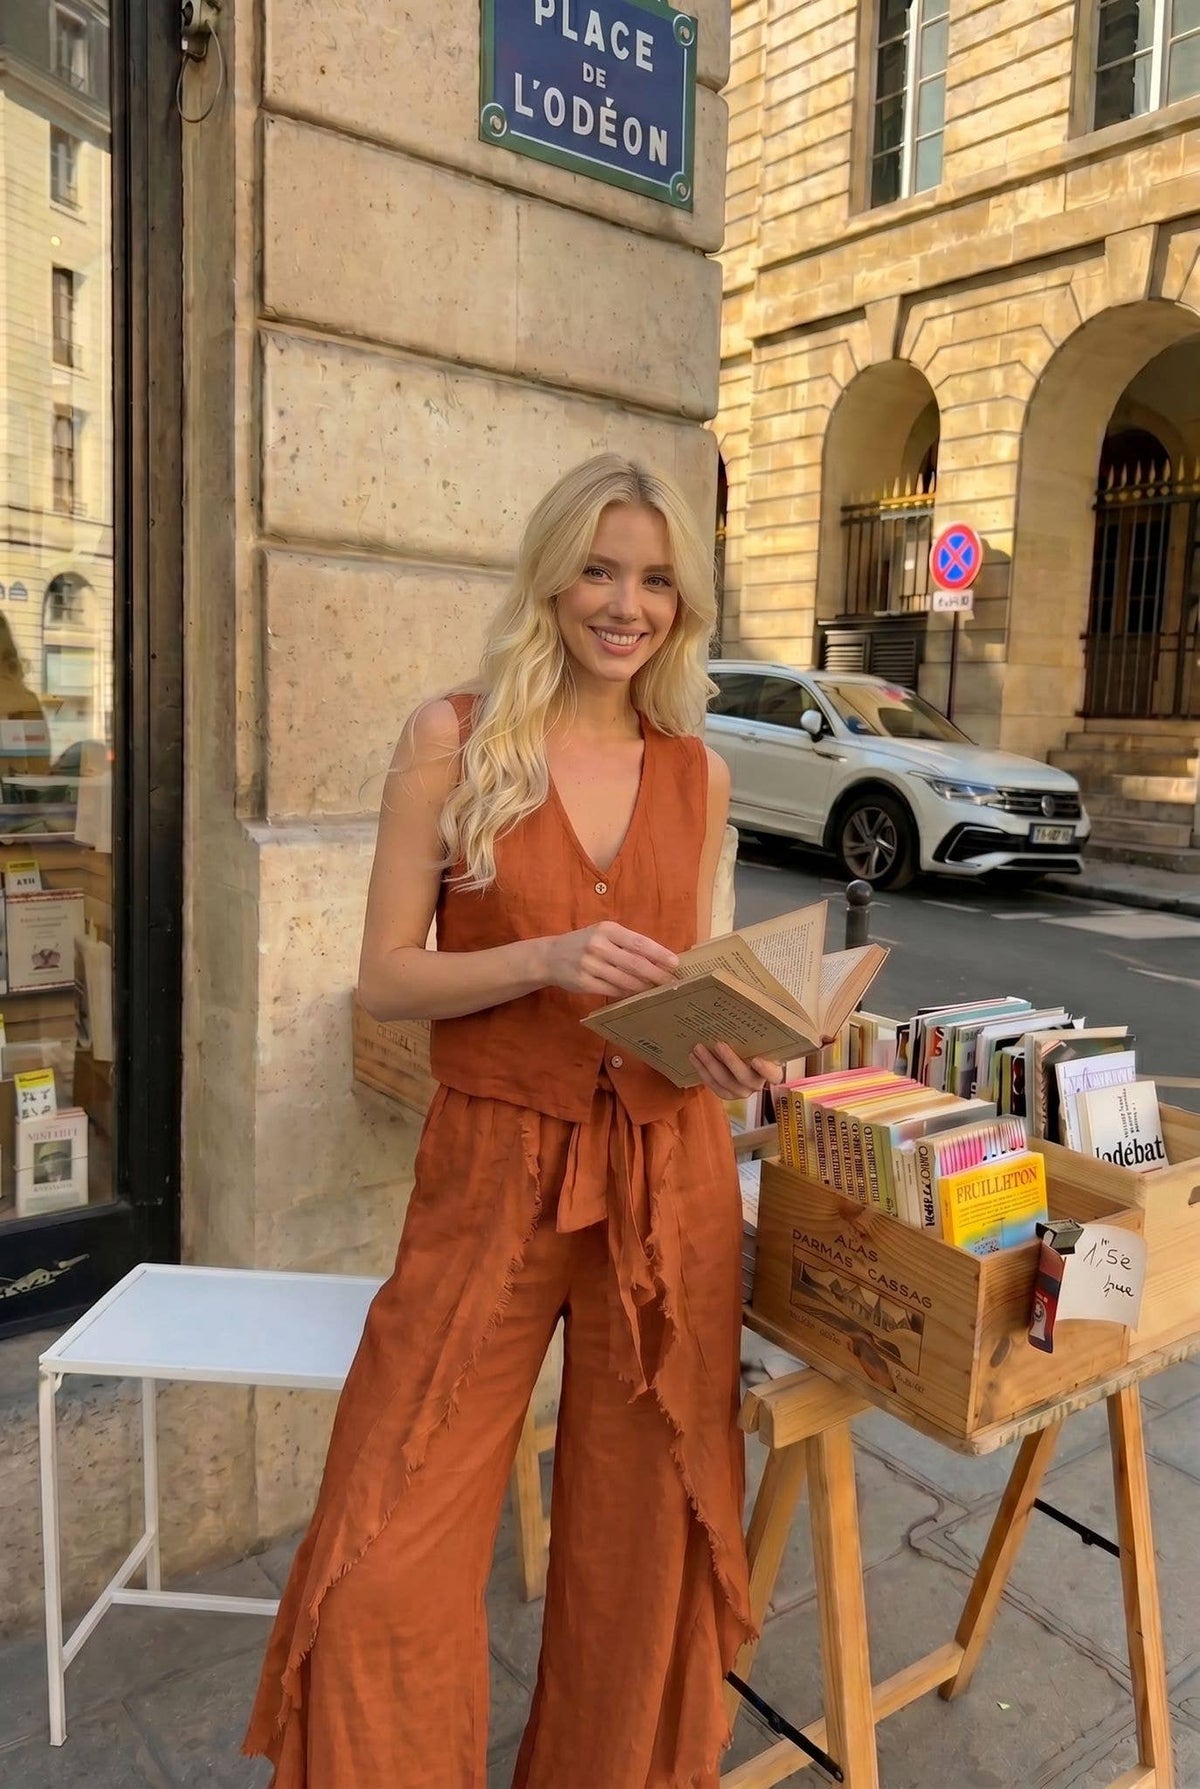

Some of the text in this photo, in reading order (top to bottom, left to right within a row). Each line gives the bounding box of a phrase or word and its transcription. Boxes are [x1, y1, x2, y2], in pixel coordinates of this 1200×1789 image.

[535, 0, 653, 72] PLACE
[583, 62, 606, 88] DE
[515, 72, 667, 166] L'ODÉON
[792, 1229, 932, 1309] DARMAS CASSAG
